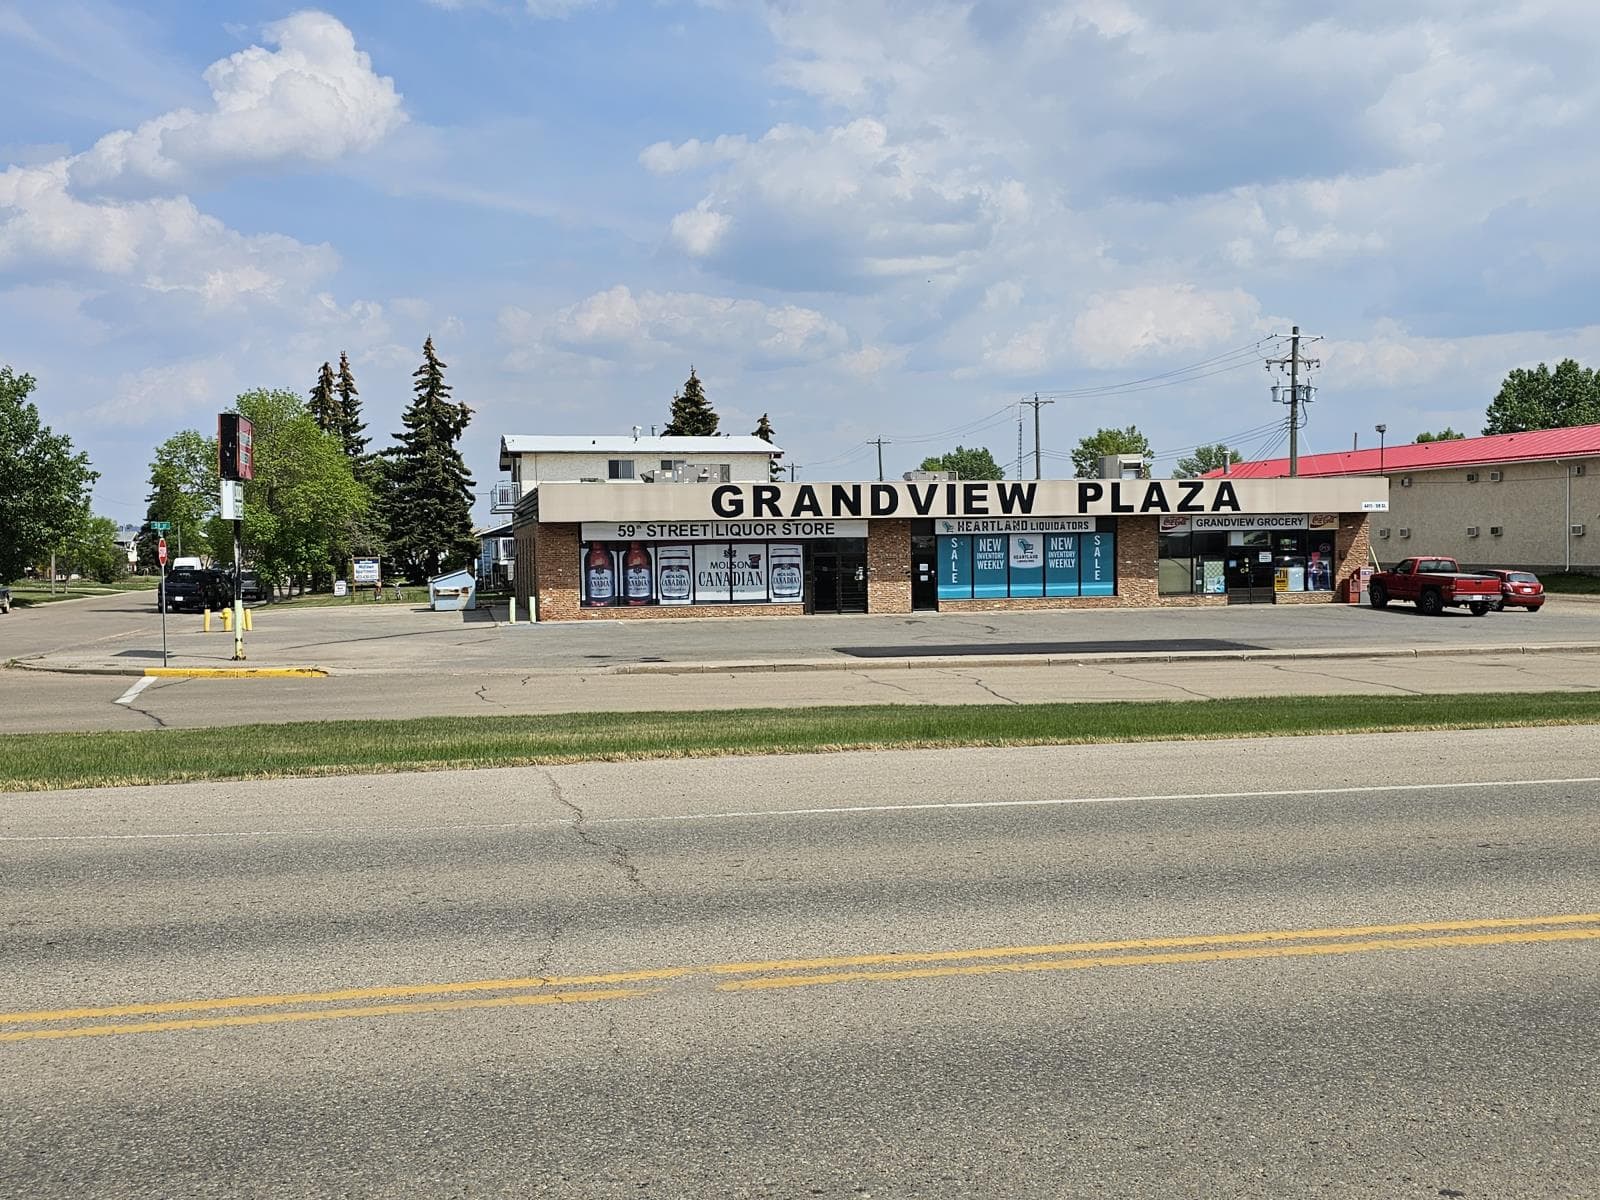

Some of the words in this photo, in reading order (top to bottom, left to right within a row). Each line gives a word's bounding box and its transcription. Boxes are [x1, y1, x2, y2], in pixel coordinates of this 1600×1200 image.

[711, 483, 1037, 518] GRANDVIEW
[1078, 481, 1241, 514] PLAZA
[957, 520, 1028, 532] HEARTLAND
[1030, 520, 1089, 531] LIQUIDATORS
[1196, 517, 1254, 527] GRANDVIEW
[1256, 516, 1304, 527] GROCERY
[646, 523, 710, 537] STREET
[715, 522, 776, 537] LIQUOR
[782, 522, 835, 536] STORE
[979, 538, 1001, 552] NEW
[1051, 537, 1073, 550] NEW
[976, 552, 1004, 560] INVENTORY
[1048, 551, 1076, 559] INVENTORY
[710, 560, 751, 570] MOLSON
[977, 560, 1004, 570] WEEKLY
[1049, 558, 1076, 569] WEEKLY
[698, 570, 764, 587] CANADIAN
